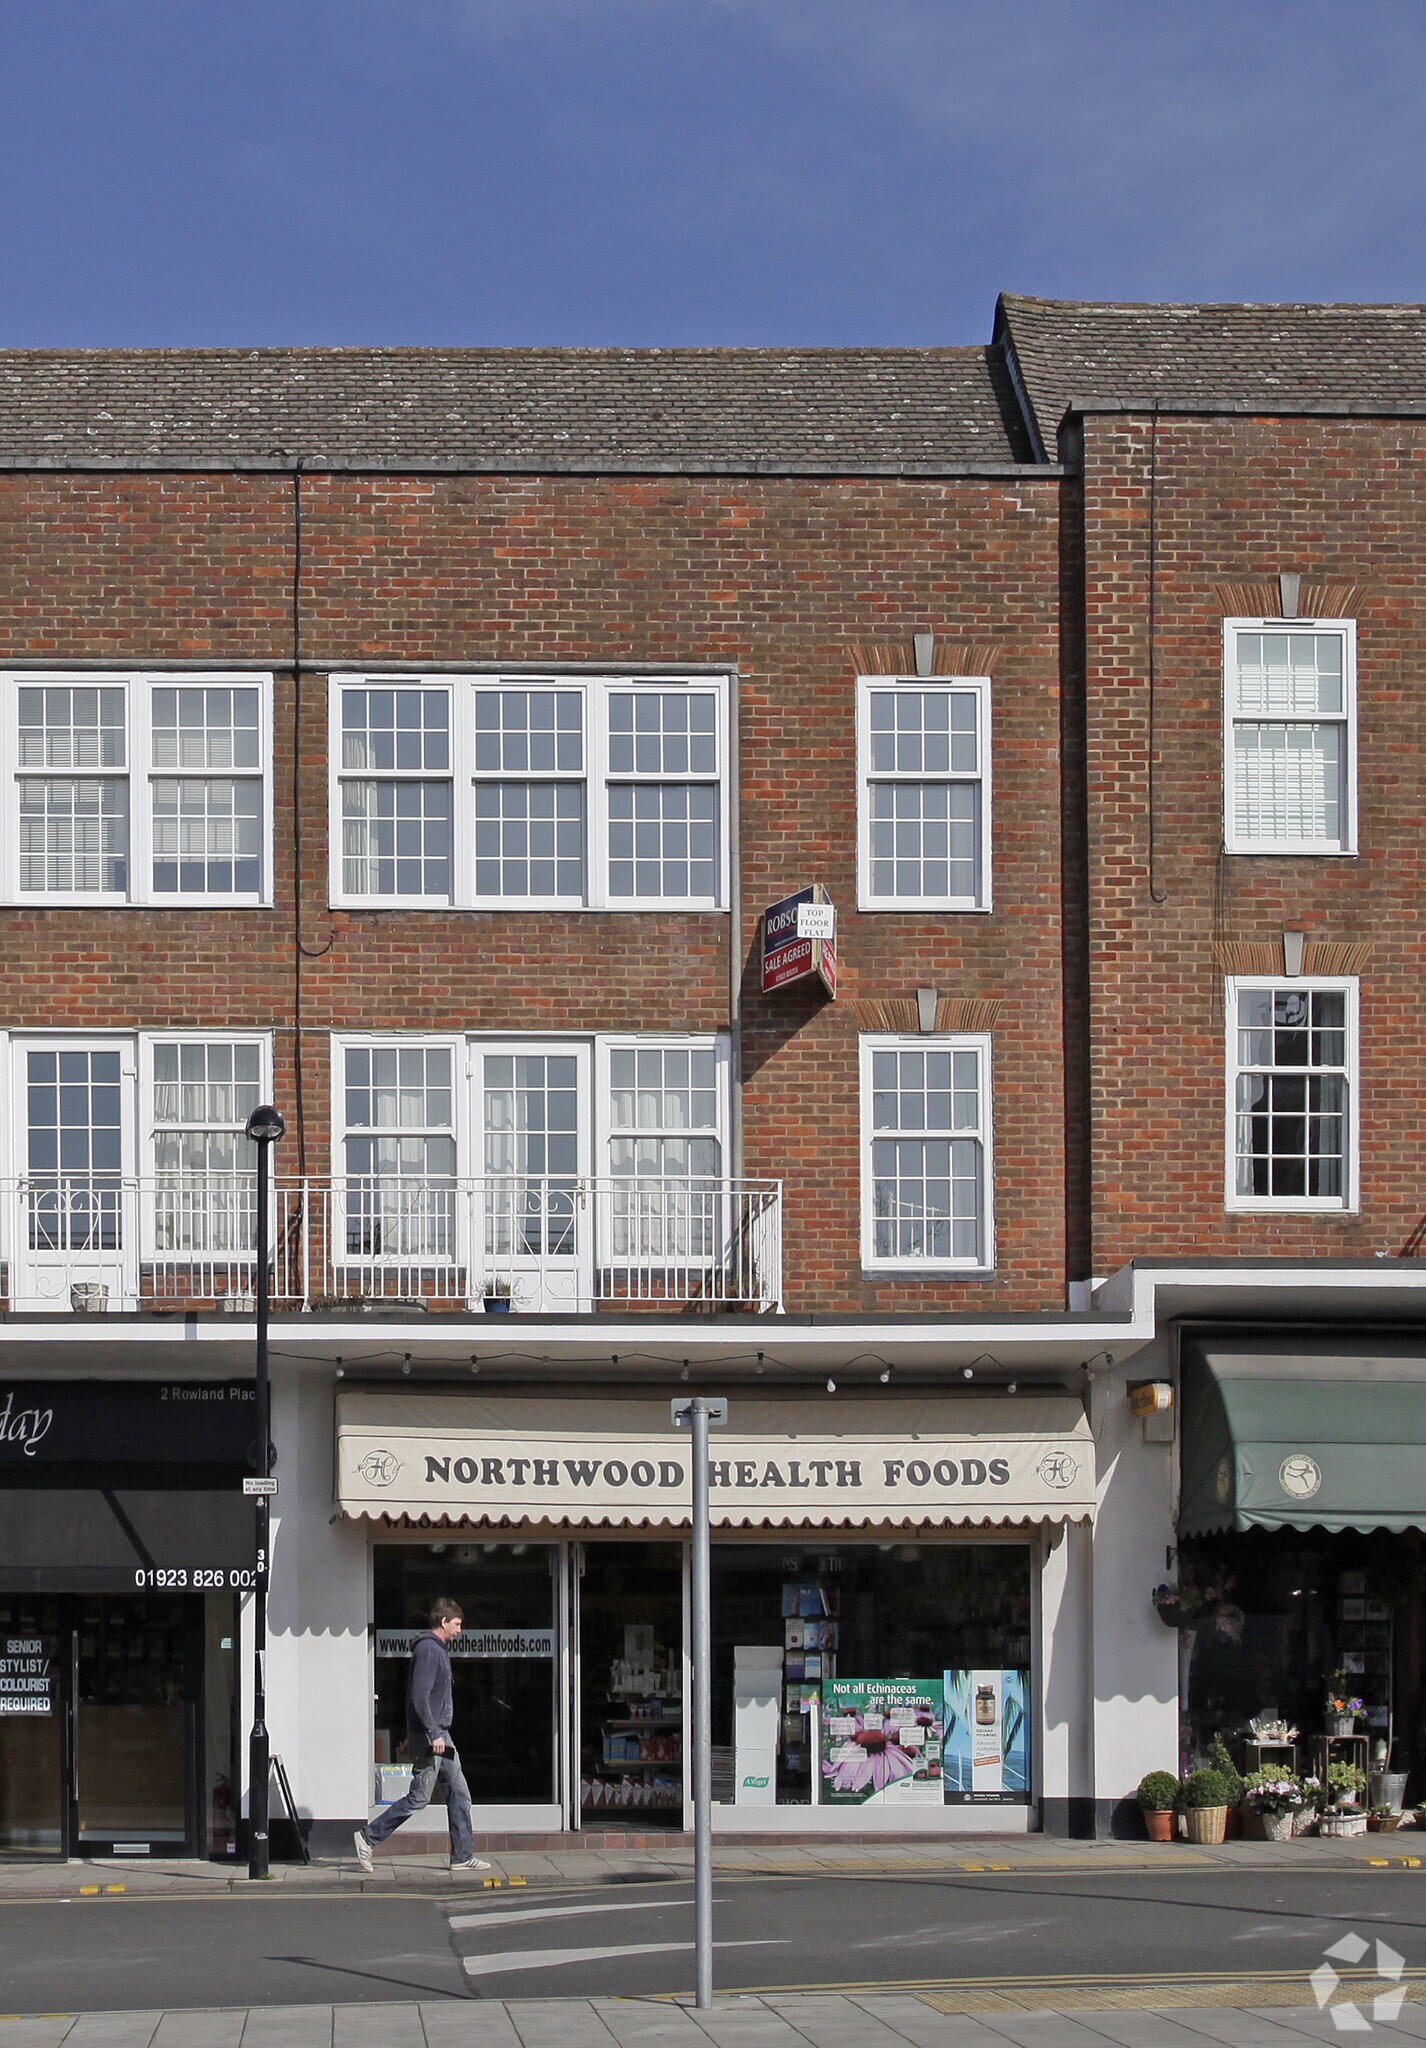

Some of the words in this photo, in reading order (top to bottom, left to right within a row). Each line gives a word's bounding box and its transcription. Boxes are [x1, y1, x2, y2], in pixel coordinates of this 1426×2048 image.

[806, 909, 824, 917] TOP
[767, 906, 798, 935] ROBSO
[800, 919, 829, 927] FLOOR
[804, 929, 825, 937] FLAT
[764, 955, 781, 975] SALE
[782, 941, 811, 967] AGREED
[161, 1387, 168, 1400] 2
[172, 1387, 225, 1400] Rowland
[229, 1387, 256, 1400] Plac
[424, 1456, 685, 1488] NORTHWOOD
[708, 1459, 863, 1488] HEALTH
[882, 1458, 1011, 1487] FOODS
[135, 1569, 187, 1587] 01923
[193, 1569, 224, 1587] 826
[7, 1640, 42, 1654] SENIOR
[0, 1659, 49, 1676] STYLIST/
[0, 1678, 50, 1692] COLOURIST
[833, 1683, 850, 1694] Not
[853, 1682, 865, 1694] all
[867, 1683, 917, 1694] Echinaceas
[0, 1696, 51, 1711] REQUIRED
[870, 1696, 885, 1705] are
[887, 1694, 903, 1705] the
[905, 1696, 934, 1705] same.
